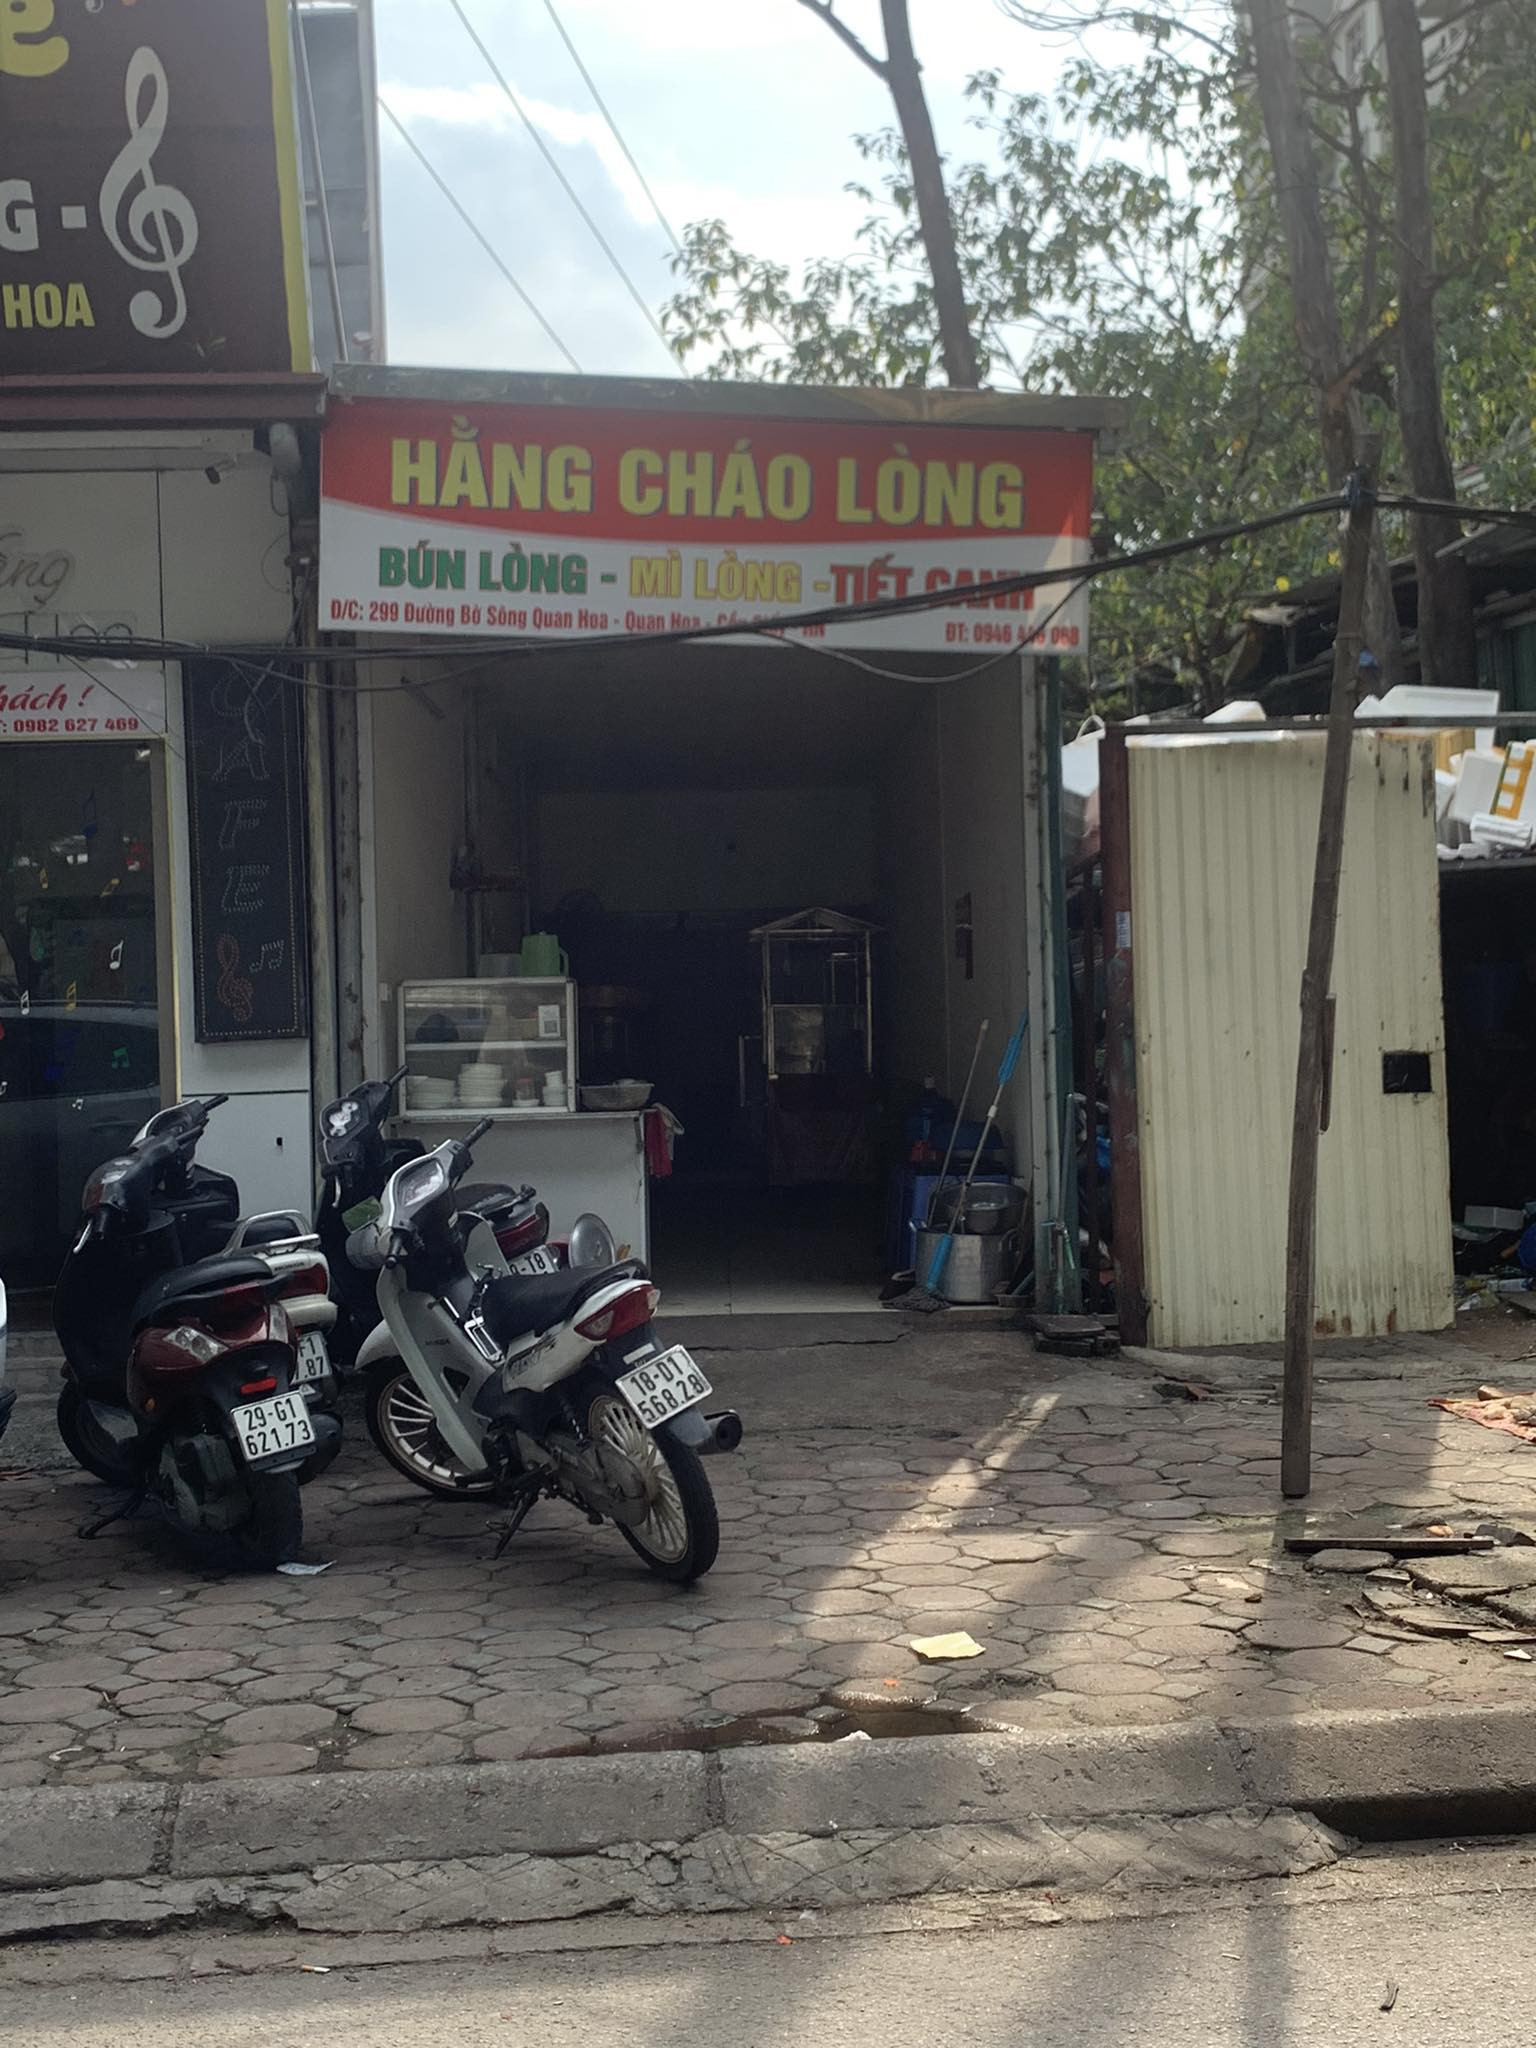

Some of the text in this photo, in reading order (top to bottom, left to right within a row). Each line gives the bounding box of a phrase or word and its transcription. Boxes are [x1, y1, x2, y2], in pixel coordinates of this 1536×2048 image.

[3, 283, 95, 328] HOA
[392, 415, 1023, 528] HẰNG CHÁO LÒNG
[379, 540, 466, 590] BÚN
[479, 542, 588, 594] LÒNG
[630, 549, 682, 598] MÌ
[694, 550, 802, 603] LÒNG
[830, 553, 913, 604] TIẾT
[369, 602, 398, 622] 299
[487, 605, 527, 629] Sông
[532, 607, 572, 629] Quan
[578, 609, 608, 629] Hoa
[625, 611, 665, 632] Quan
[14, 719, 58, 732] 0982
[65, 719, 97, 732] 627
[105, 718, 138, 731] 469
[631, 1356, 684, 1396] 18-D1
[244, 1398, 296, 1431] 29-G1
[637, 1374, 705, 1423] 568.28
[246, 1420, 311, 1455] 621.73
